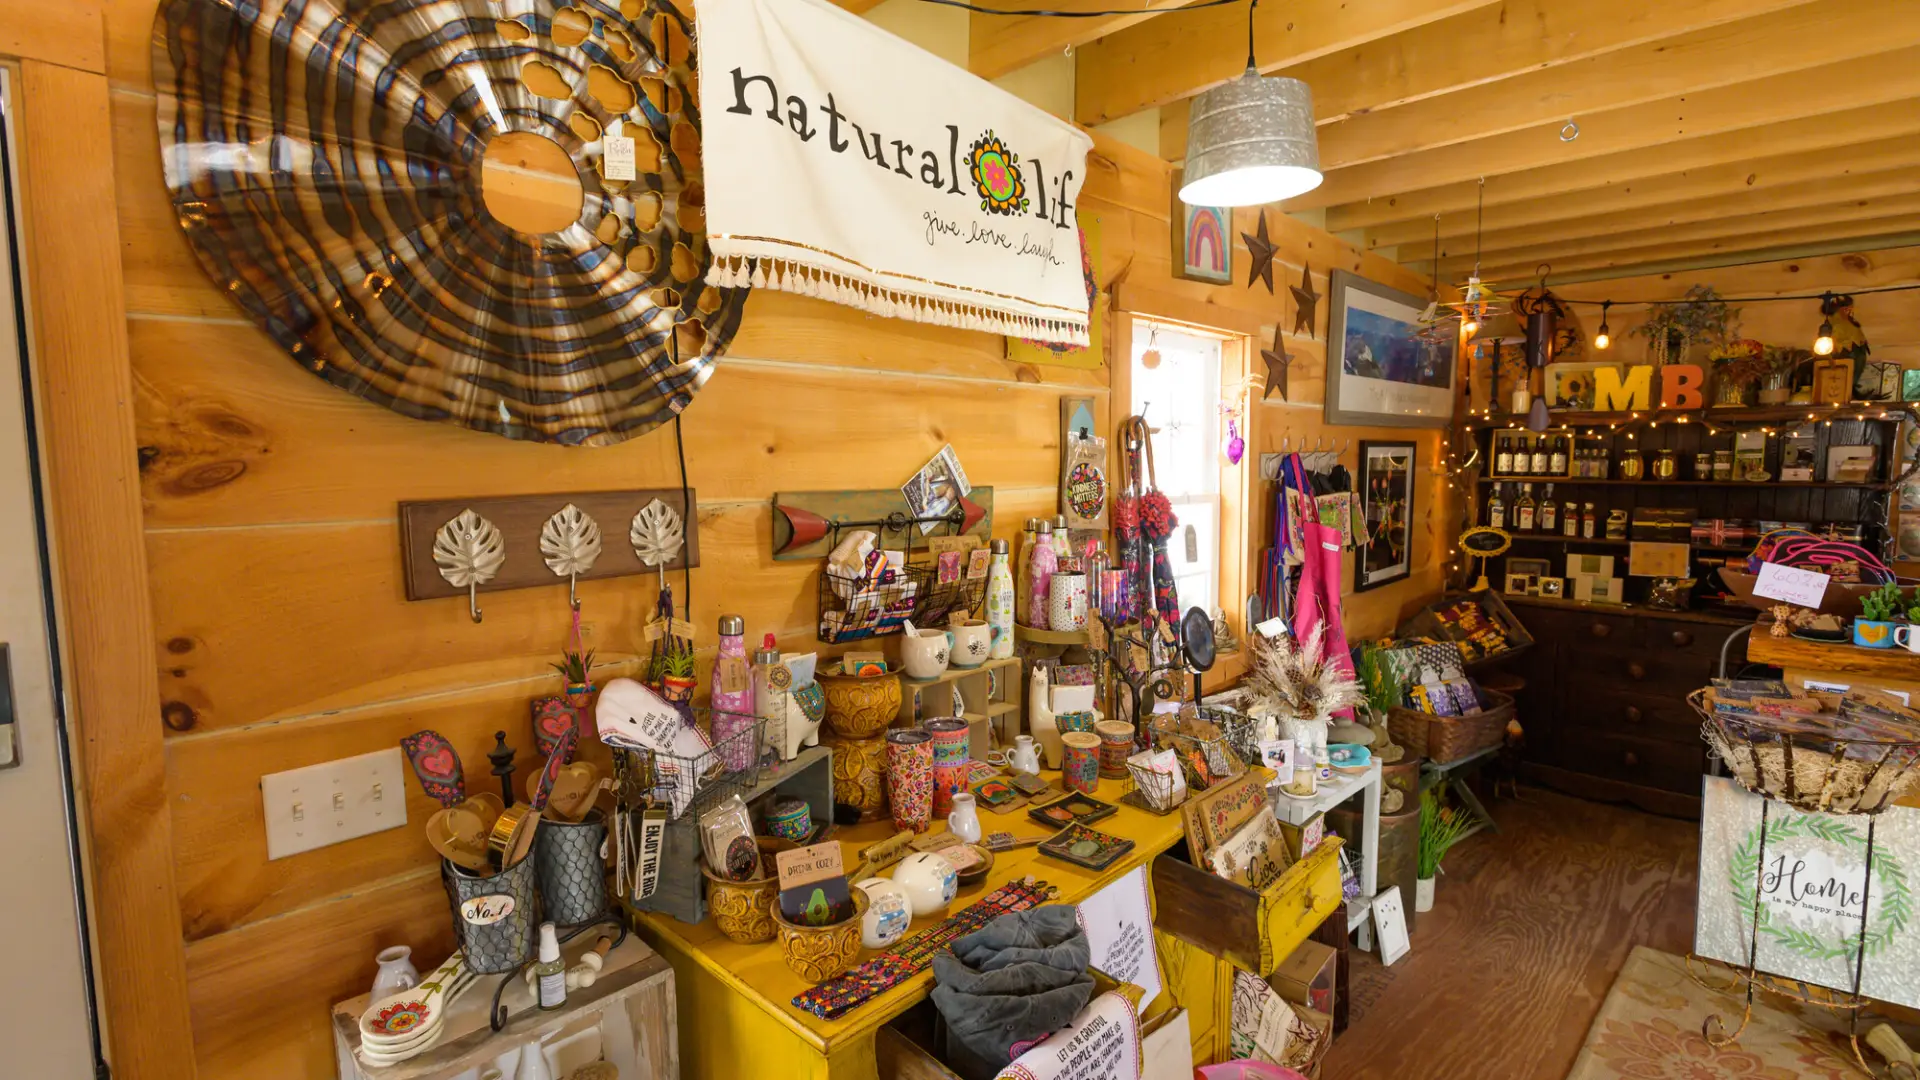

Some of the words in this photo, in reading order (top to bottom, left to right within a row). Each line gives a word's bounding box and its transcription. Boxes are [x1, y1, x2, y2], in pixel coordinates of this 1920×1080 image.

[726, 67, 966, 196] natural
[1028, 159, 1074, 230] lif
[1593, 365, 1653, 411] M
[1658, 364, 1704, 410] B
[1072, 481, 1098, 494] KINDNESS
[1073, 491, 1099, 504] MATTERS
[645, 825, 661, 855] ENJOY
[643, 856, 658, 876] THE
[787, 863, 813, 876] DRINK
[815, 857, 833, 870] COZY
[641, 876, 656, 899] RIDE
[1761, 855, 1870, 908] Home
[1785, 899, 1798, 907] my
[1802, 902, 1832, 914] happy
[1056, 1045, 1070, 1063] LET
[1066, 1041, 1078, 1053] US
[1073, 1032, 1084, 1046] BE
[1080, 1015, 1108, 1042] GRATEFUL
[1069, 1045, 1093, 1072] PEOPLE
[1090, 1038, 1102, 1052] WHO
[1101, 1026, 1115, 1045] MAKE
[1114, 1021, 1122, 1033] US
[1090, 1056, 1102, 1072] ARE
[1100, 1032, 1125, 1063] CHARMING
